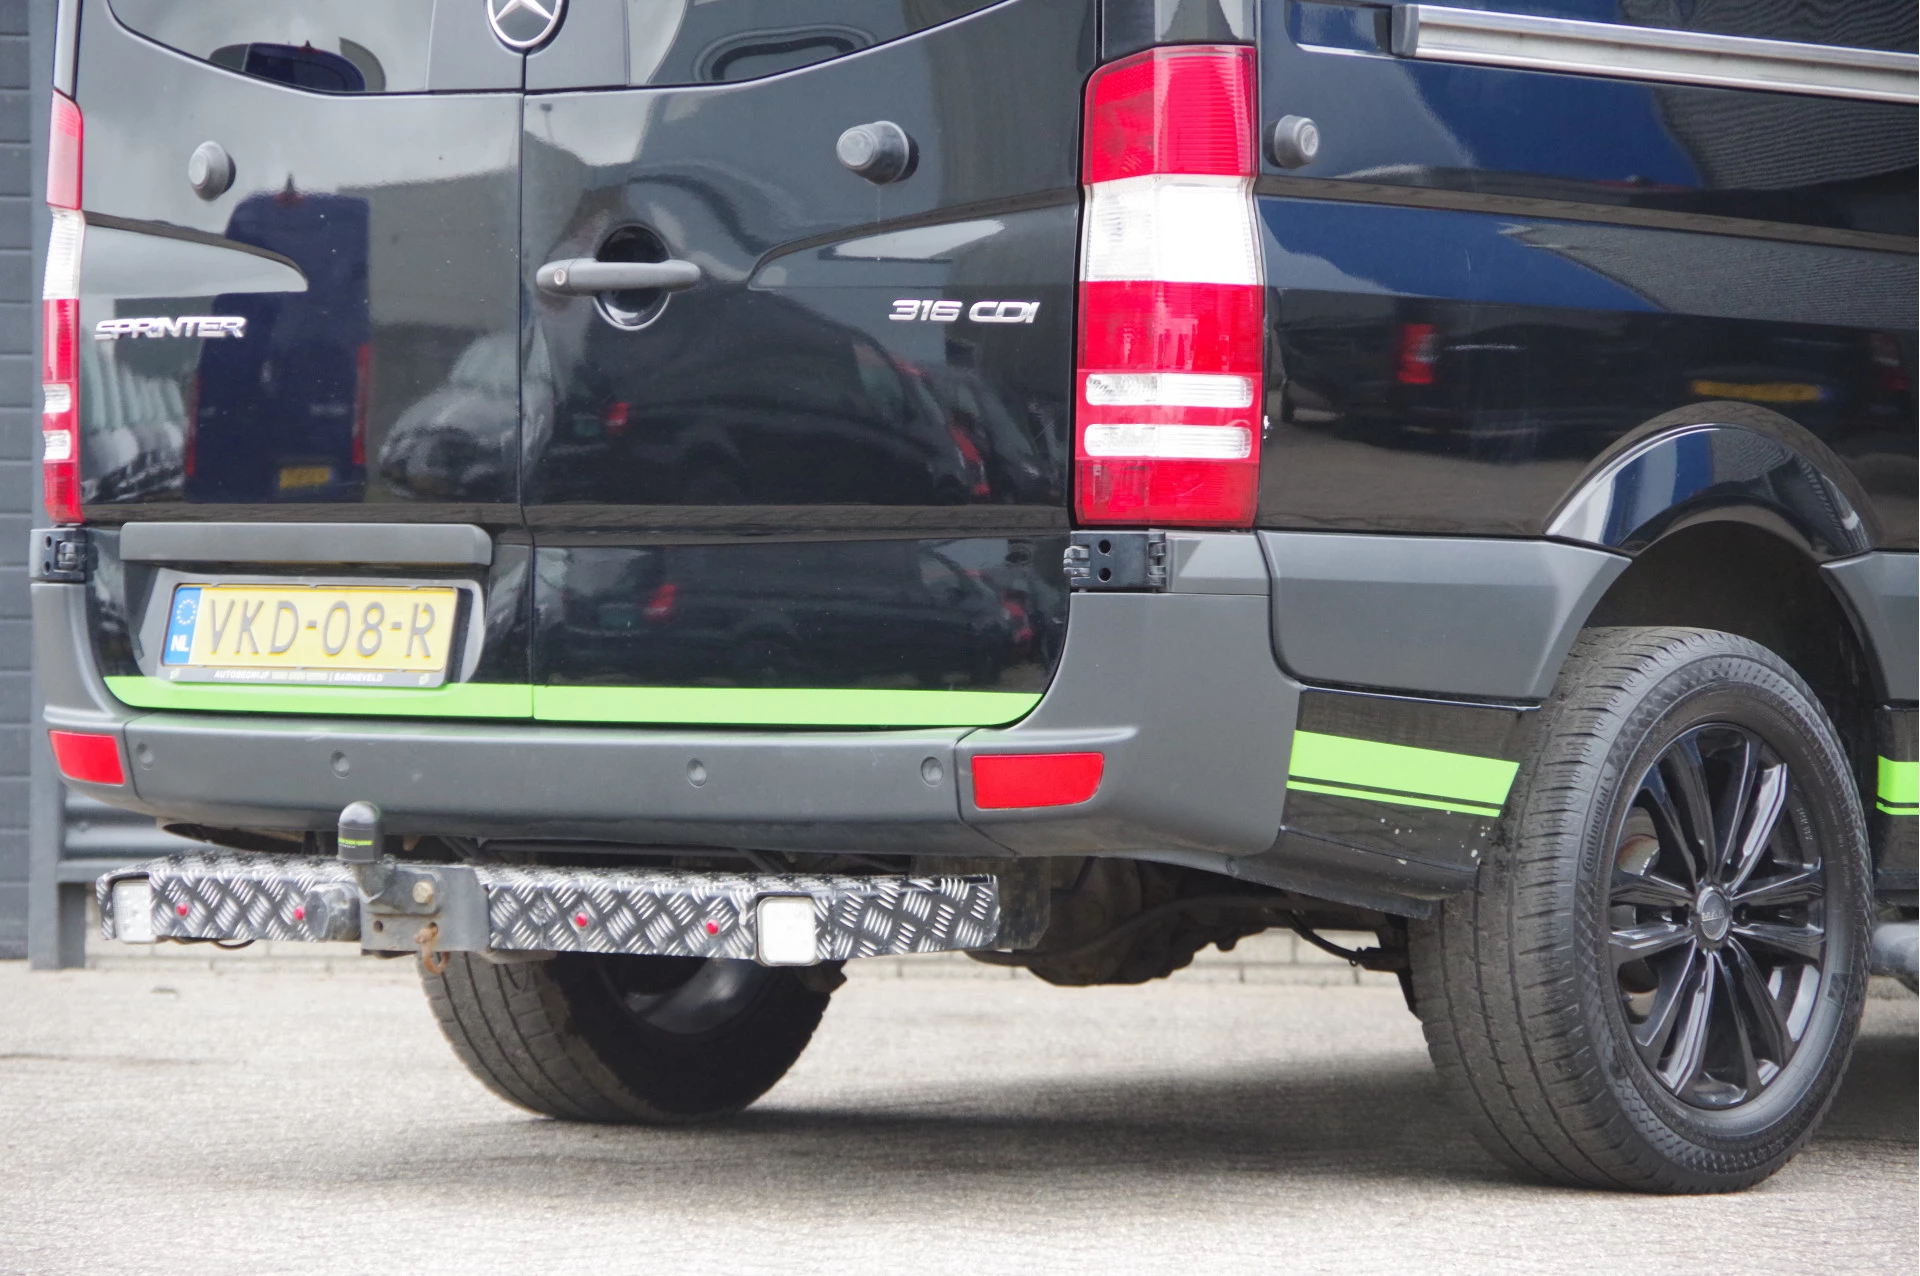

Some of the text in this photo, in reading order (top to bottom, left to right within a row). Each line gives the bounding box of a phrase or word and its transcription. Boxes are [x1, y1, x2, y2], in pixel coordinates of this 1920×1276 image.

[889, 299, 1040, 323] 316 CDI
[94, 316, 246, 340] SPRINTER
[209, 600, 436, 658] VKD-08-R
[171, 635, 189, 652] NL
[1583, 785, 1609, 873] Continental
